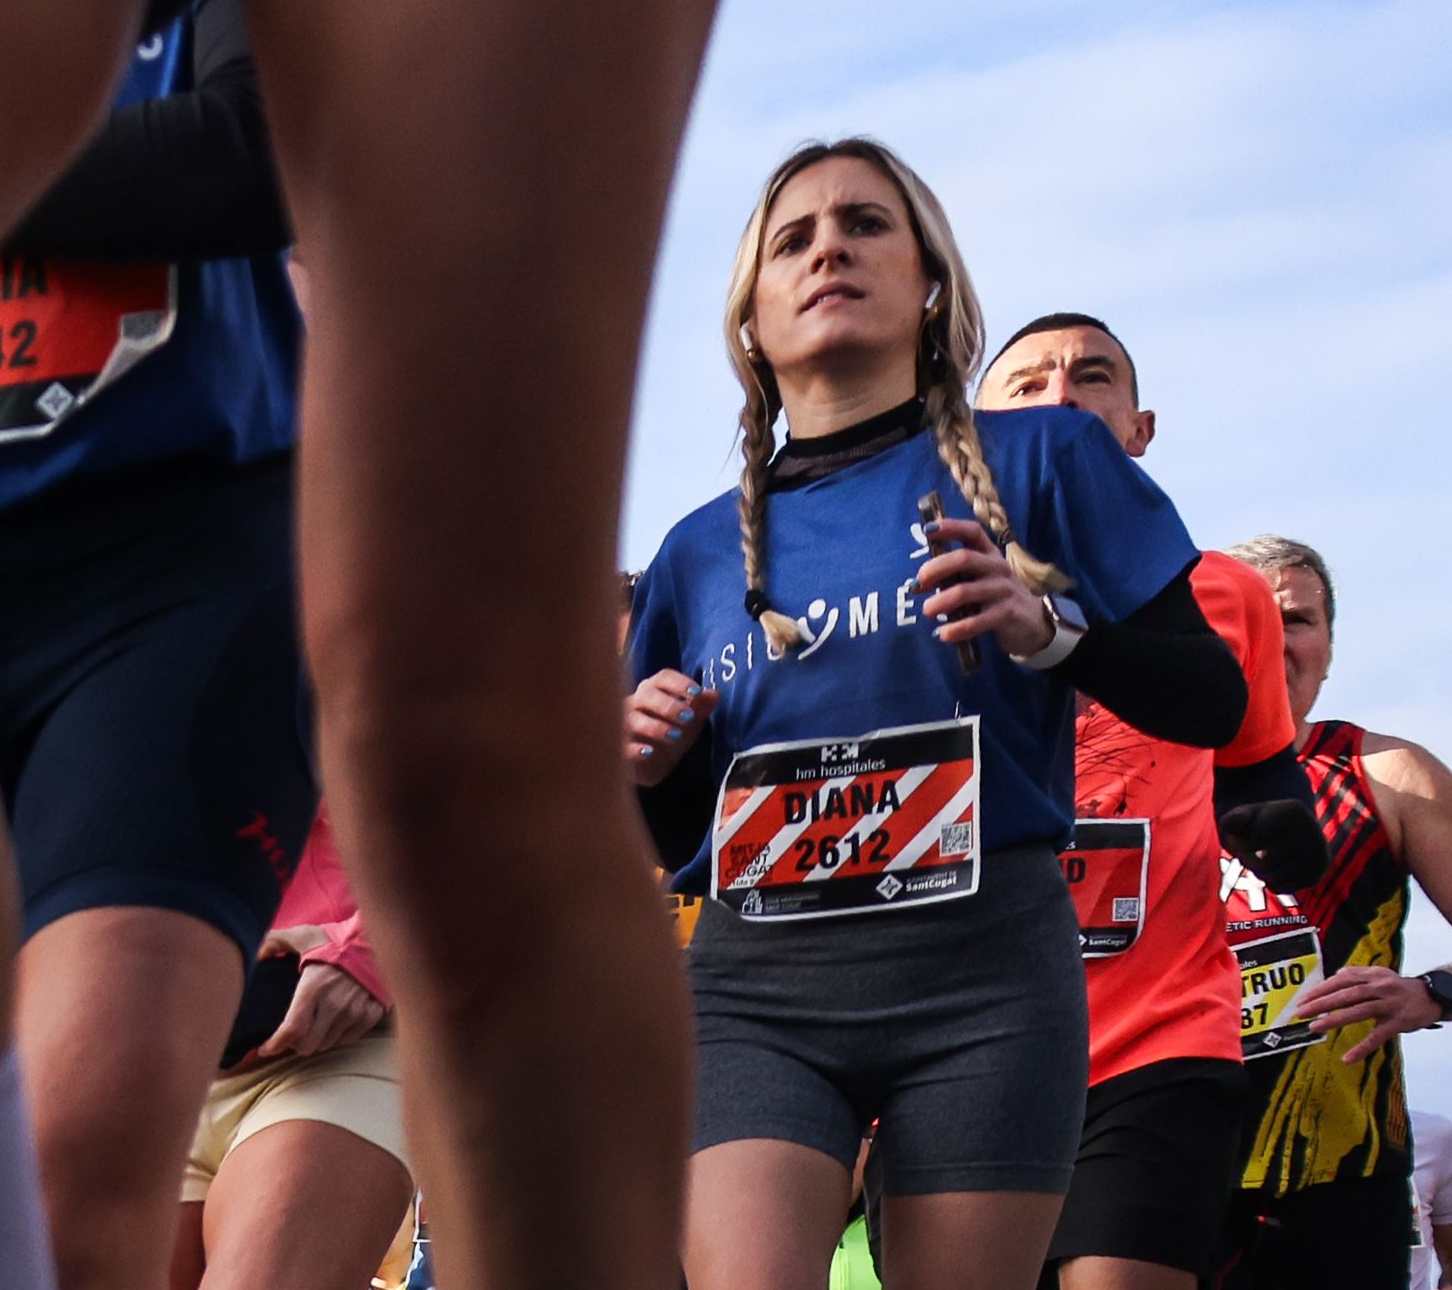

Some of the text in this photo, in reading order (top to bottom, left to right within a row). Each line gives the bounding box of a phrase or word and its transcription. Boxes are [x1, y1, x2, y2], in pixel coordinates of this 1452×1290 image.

[796, 758, 887, 781] hm hospitales
[784, 779, 902, 827] DIANA
[794, 828, 892, 873] 2612
[906, 876, 957, 892] SantCugat
[1254, 915, 1309, 929] RUNNING
